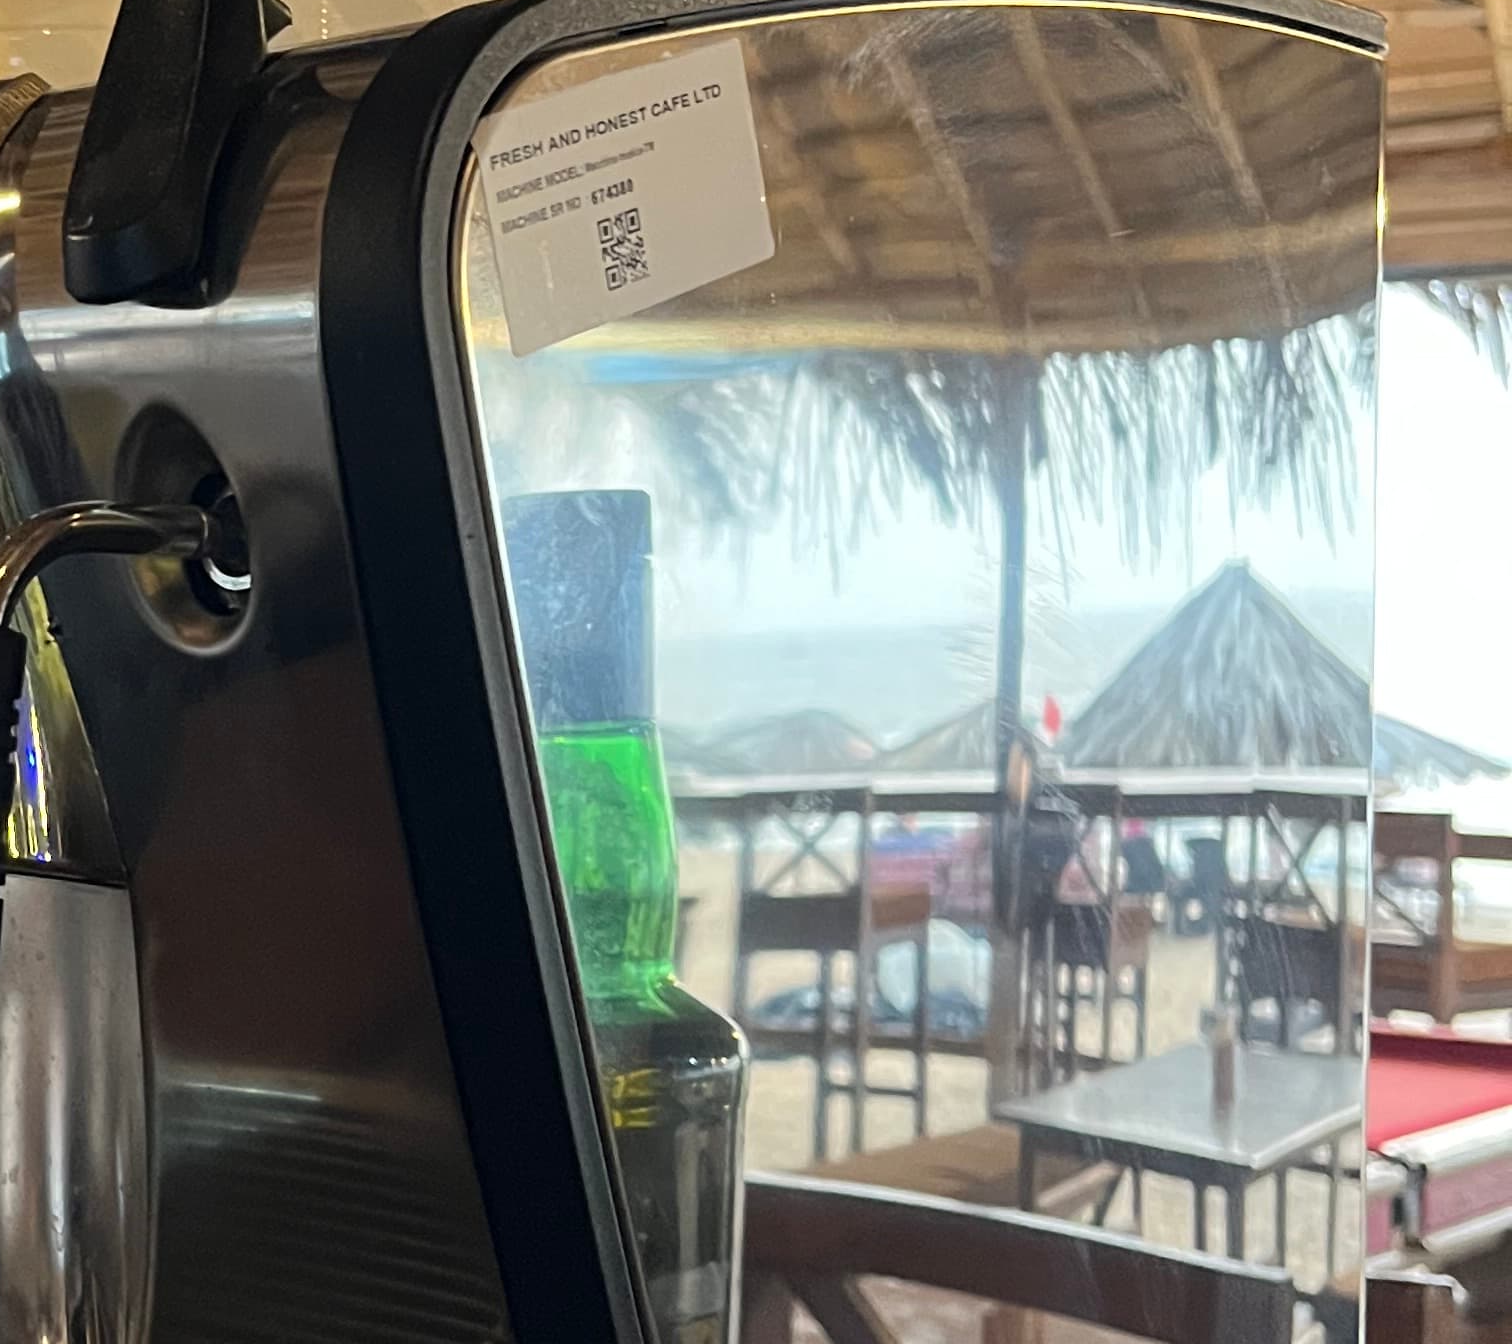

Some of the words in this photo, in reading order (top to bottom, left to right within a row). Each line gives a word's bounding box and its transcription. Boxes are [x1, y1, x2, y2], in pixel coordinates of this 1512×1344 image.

[489, 140, 544, 171] FRESH
[548, 129, 582, 152] AND
[585, 106, 647, 140] HONEST
[651, 93, 691, 117] CAFE
[693, 84, 722, 104] LTD
